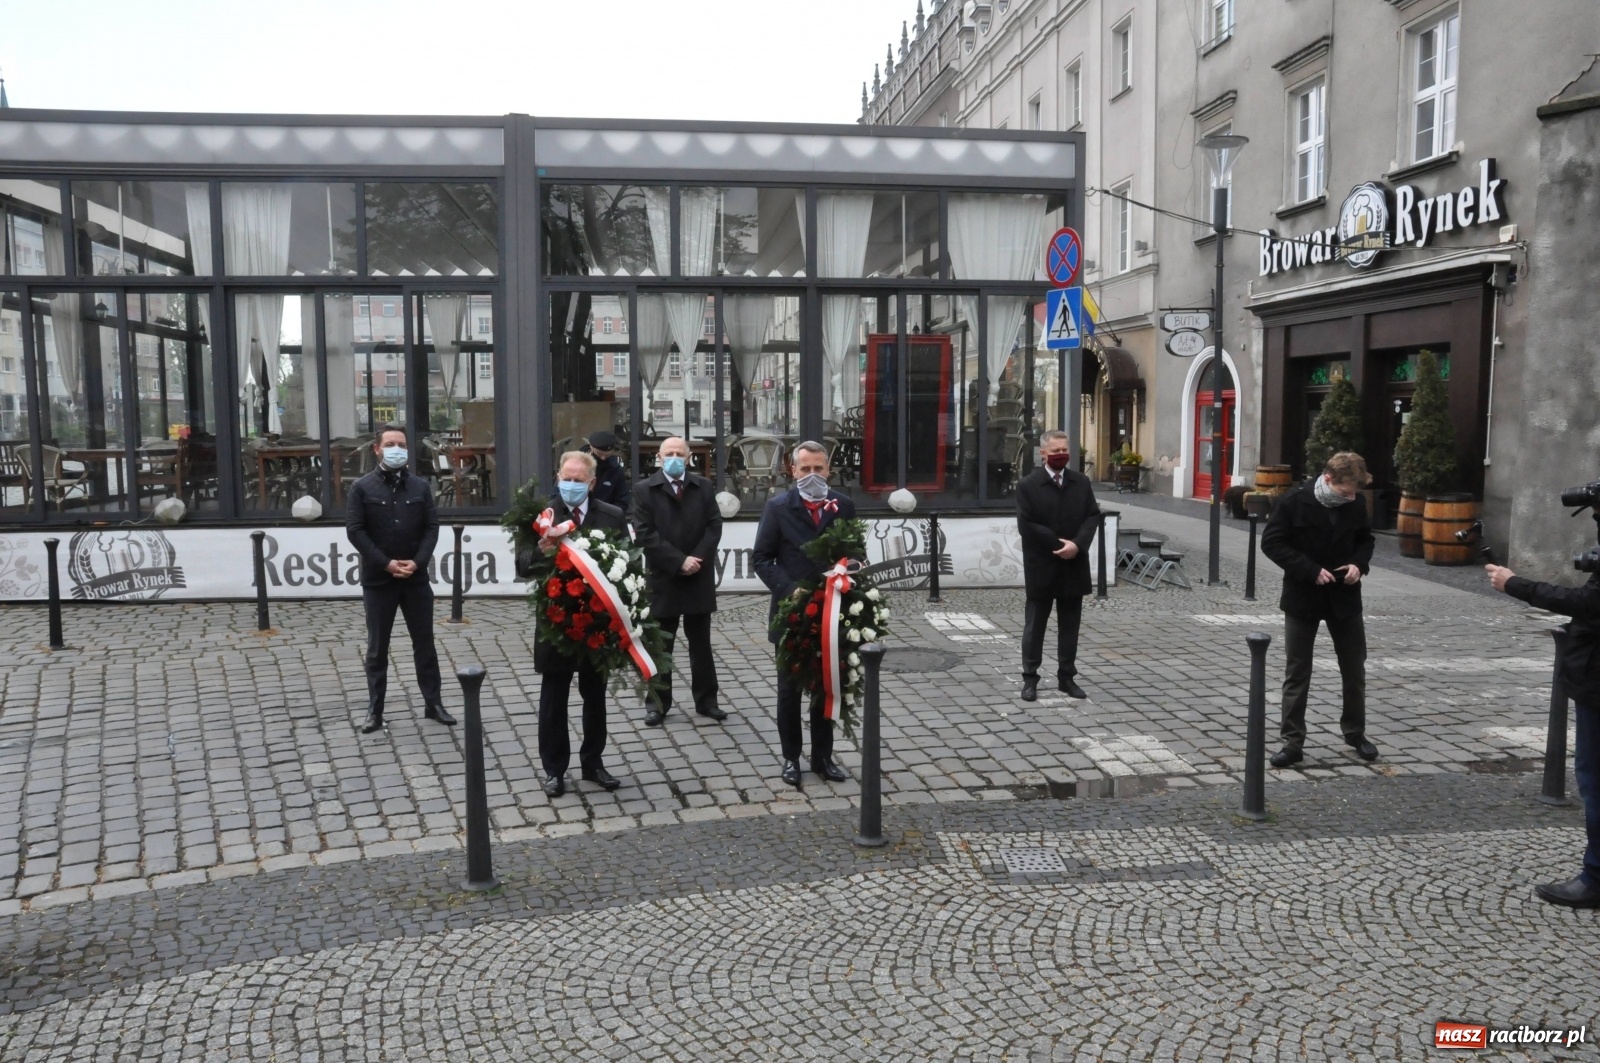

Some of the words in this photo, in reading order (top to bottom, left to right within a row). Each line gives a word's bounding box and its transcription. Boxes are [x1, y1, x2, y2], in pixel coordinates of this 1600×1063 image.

[1259, 226, 1337, 276] Browar
[1395, 158, 1500, 248] Rynek
[1174, 315, 1200, 327] BUTIK
[251, 534, 499, 594] Restacja
[872, 566, 901, 583] owar
[904, 559, 942, 577] Ryn
[82, 579, 130, 599] Browar
[131, 569, 173, 589] Rynek
[900, 579, 914, 588] 2013
